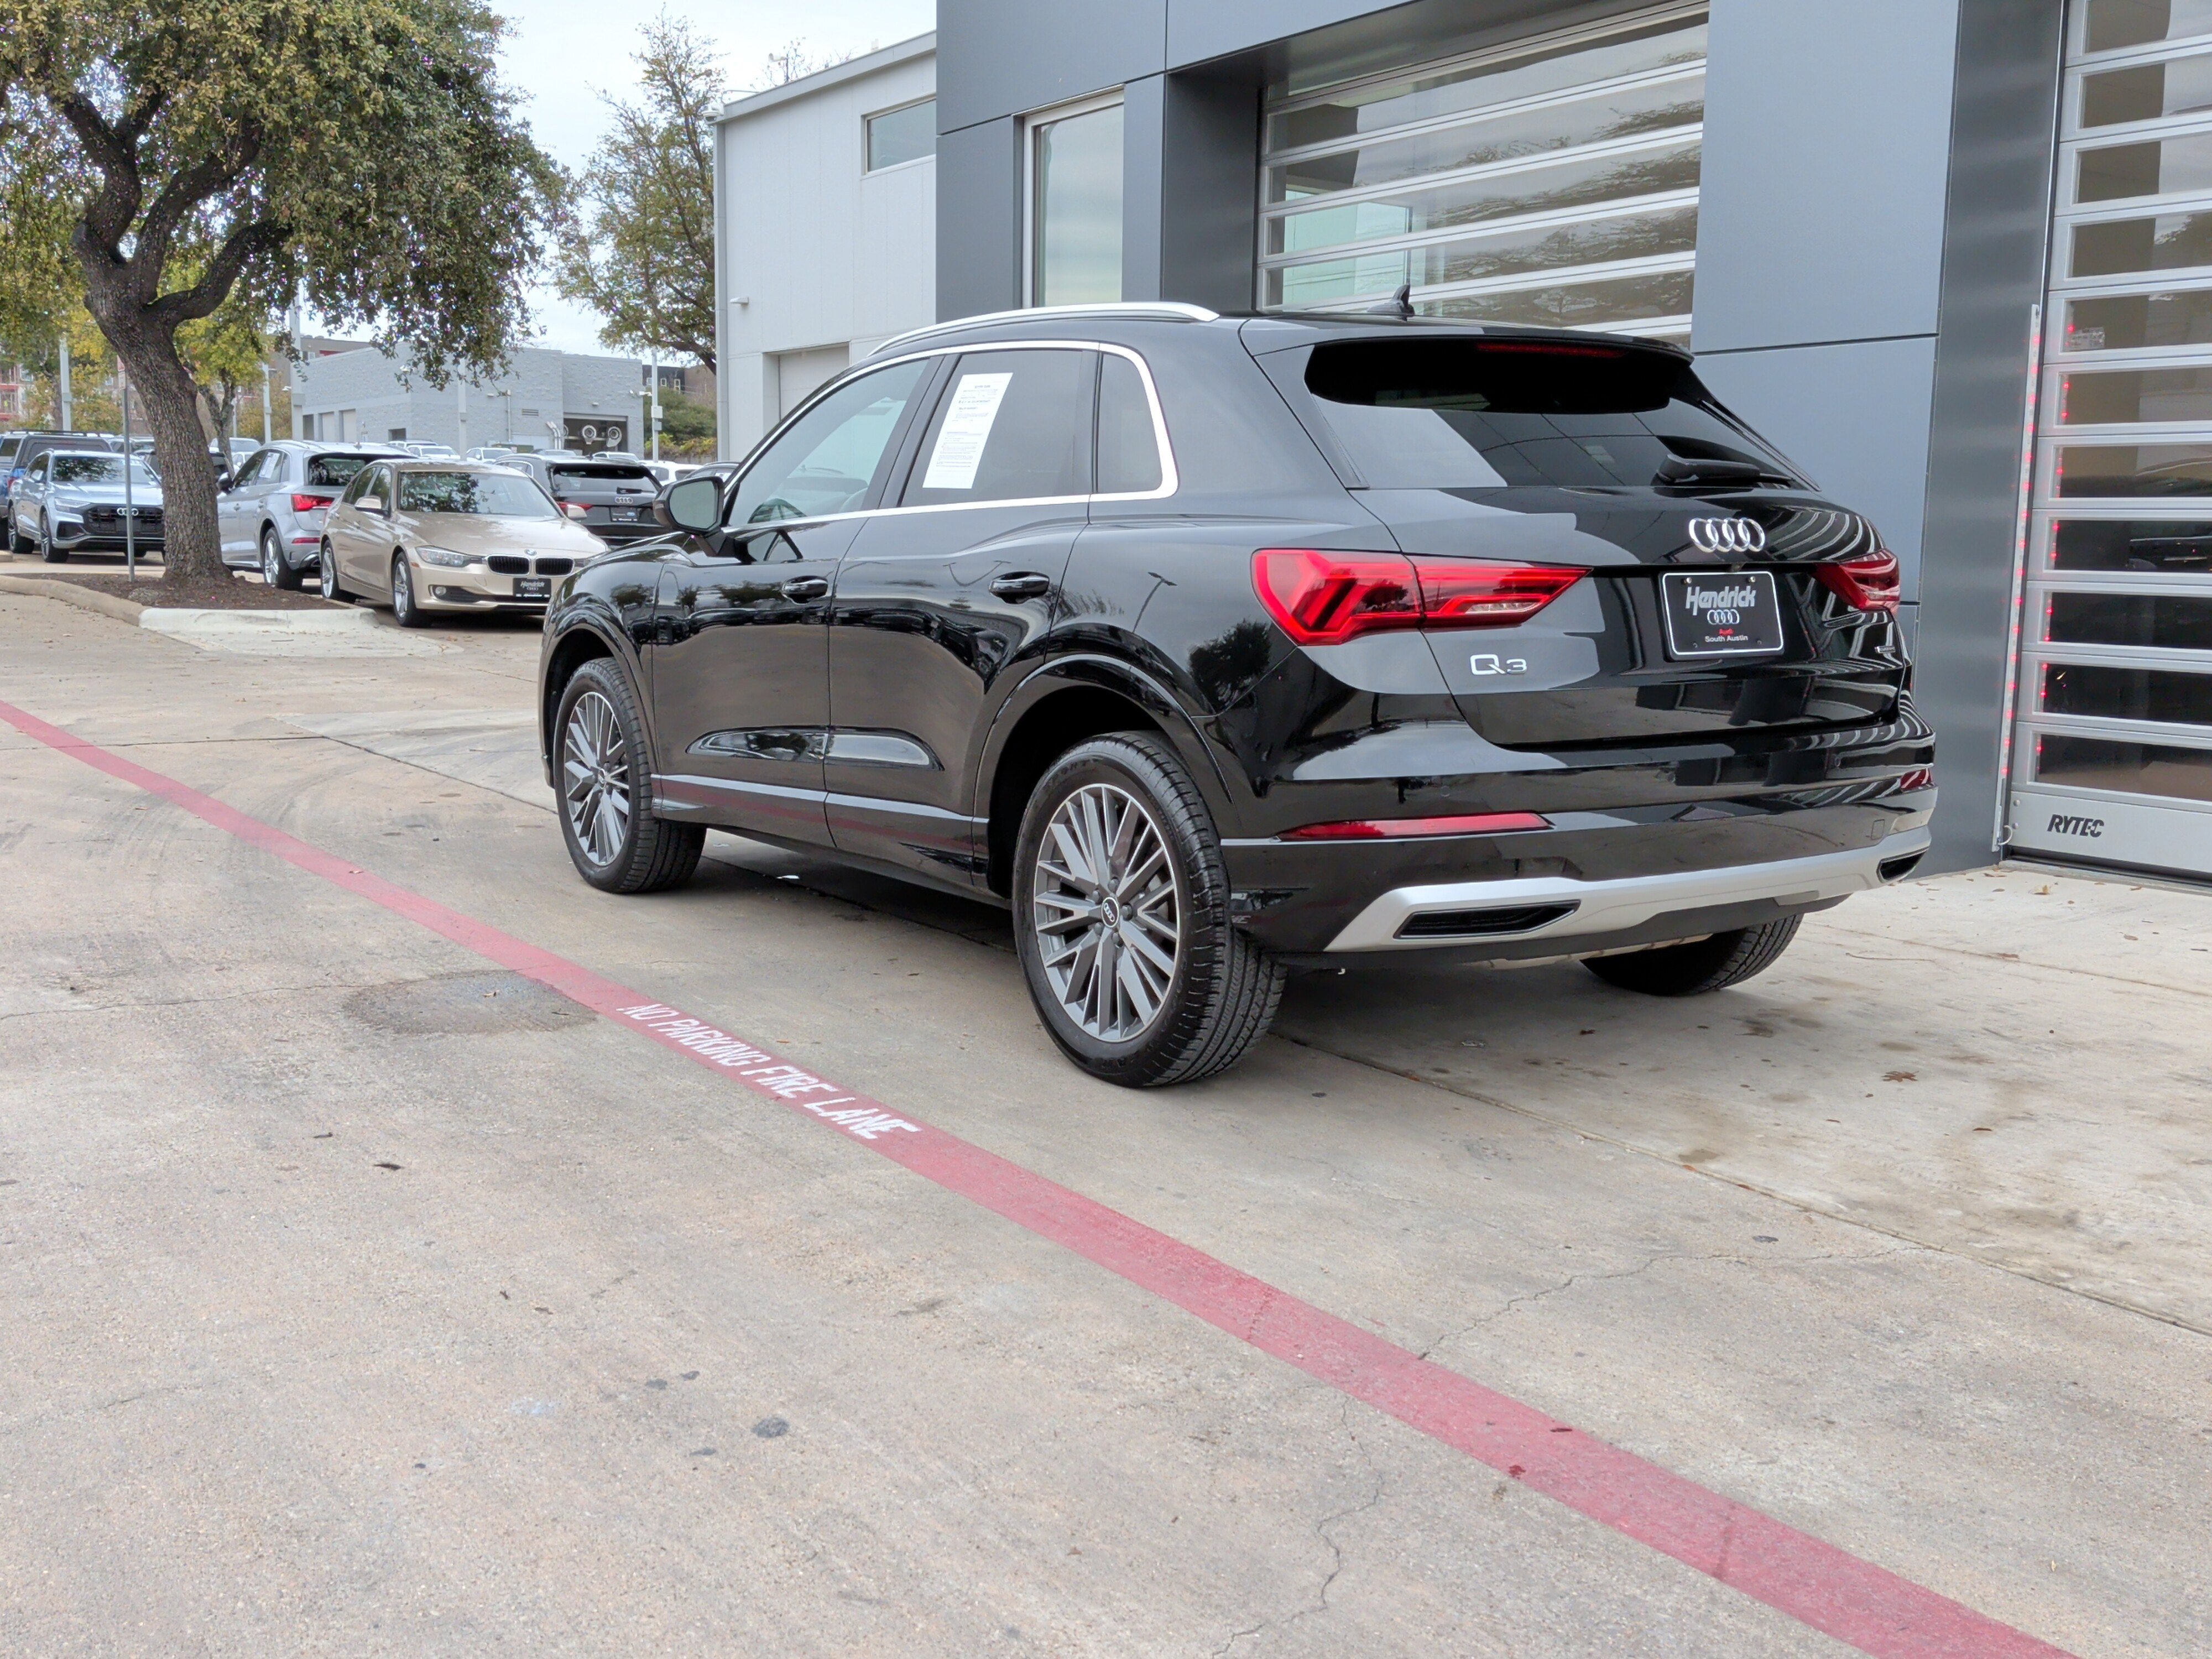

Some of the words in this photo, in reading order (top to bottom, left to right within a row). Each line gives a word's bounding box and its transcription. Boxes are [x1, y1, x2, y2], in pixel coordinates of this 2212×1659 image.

[1686, 586, 1756, 615] Hendrick
[1470, 654, 1527, 675] Q3
[2047, 814, 2105, 838] RYTEC
[616, 1003, 680, 1020] NO
[648, 1019, 771, 1067] PARKING
[740, 1065, 841, 1098] FIRE
[804, 1097, 923, 1139] LANE
